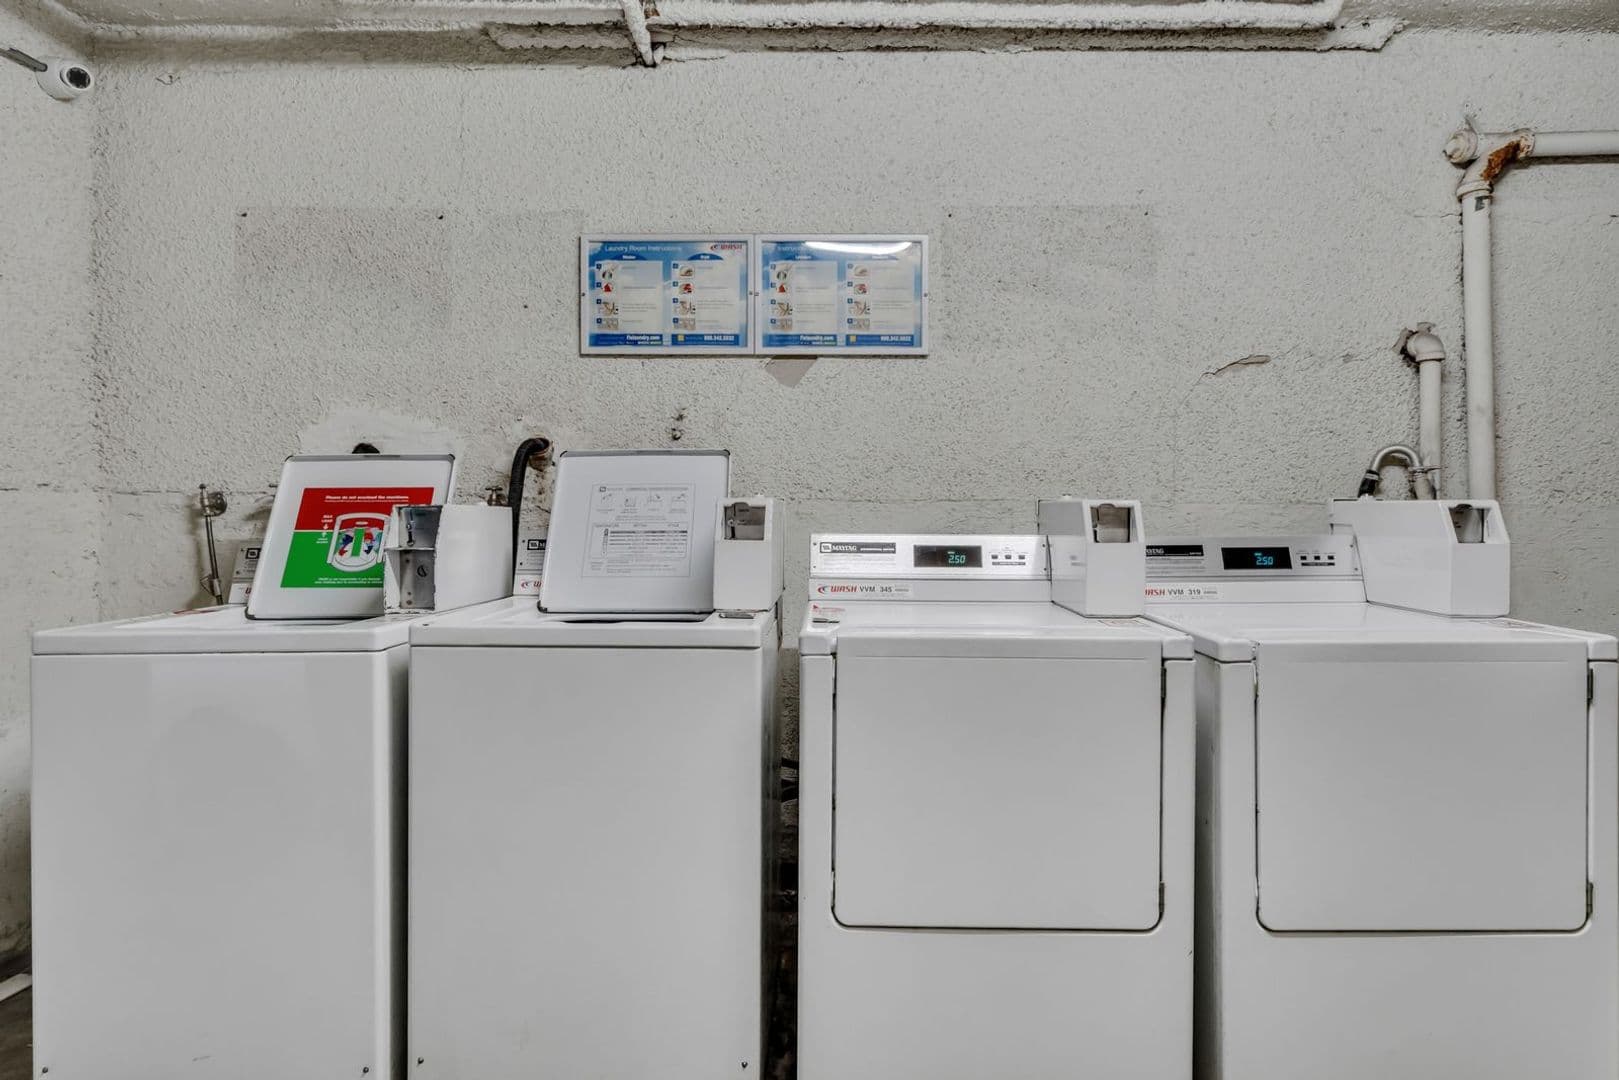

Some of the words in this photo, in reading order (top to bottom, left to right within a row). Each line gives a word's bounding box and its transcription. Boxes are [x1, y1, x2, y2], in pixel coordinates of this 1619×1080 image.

[604, 245, 628, 253] Laundry
[830, 585, 858, 593] WASH
[859, 585, 876, 593] VVM
[880, 585, 892, 593] 345
[1167, 588, 1185, 596] VVM
[1187, 588, 1202, 596] 319
